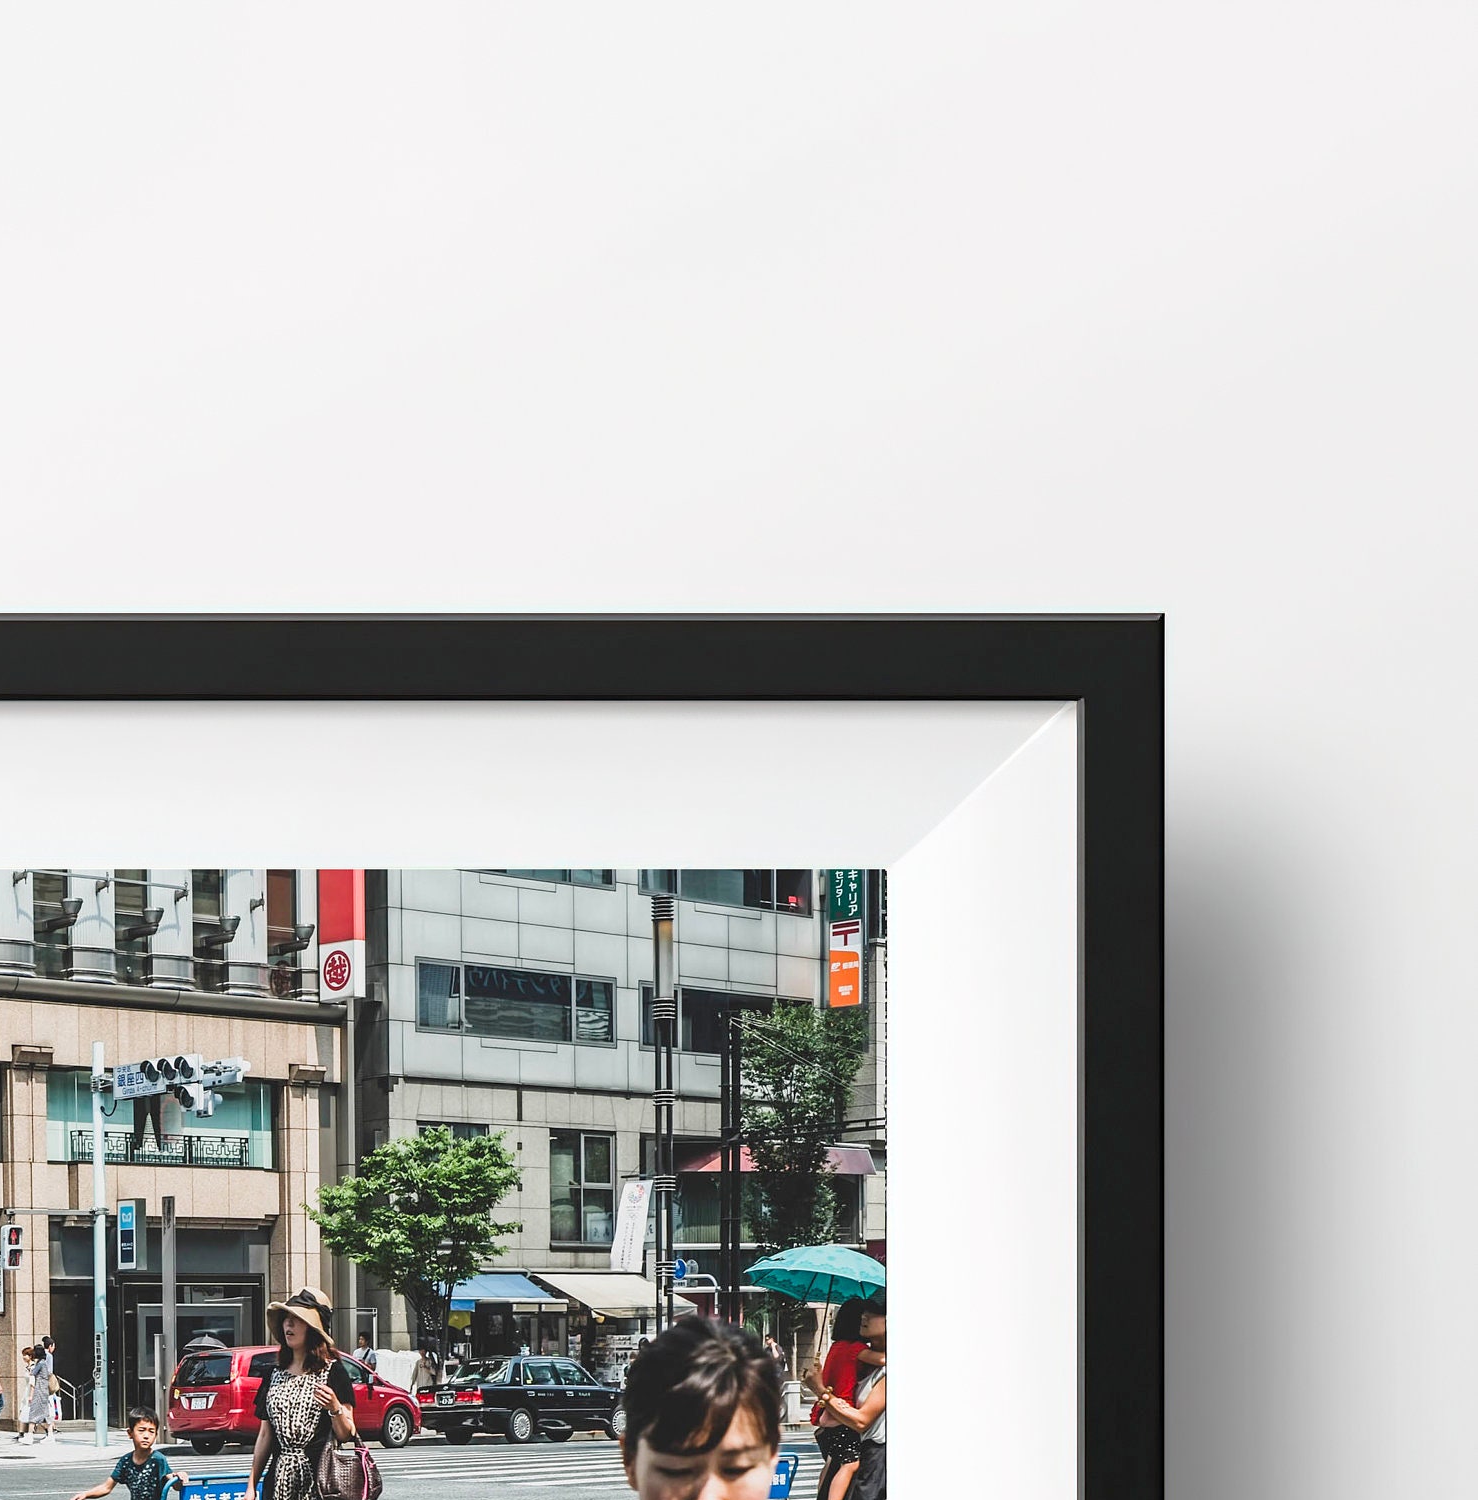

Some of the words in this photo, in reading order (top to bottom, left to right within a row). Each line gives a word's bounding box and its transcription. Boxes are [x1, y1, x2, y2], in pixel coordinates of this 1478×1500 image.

[834, 870, 844, 906] センター
[847, 869, 859, 916] キャリア
